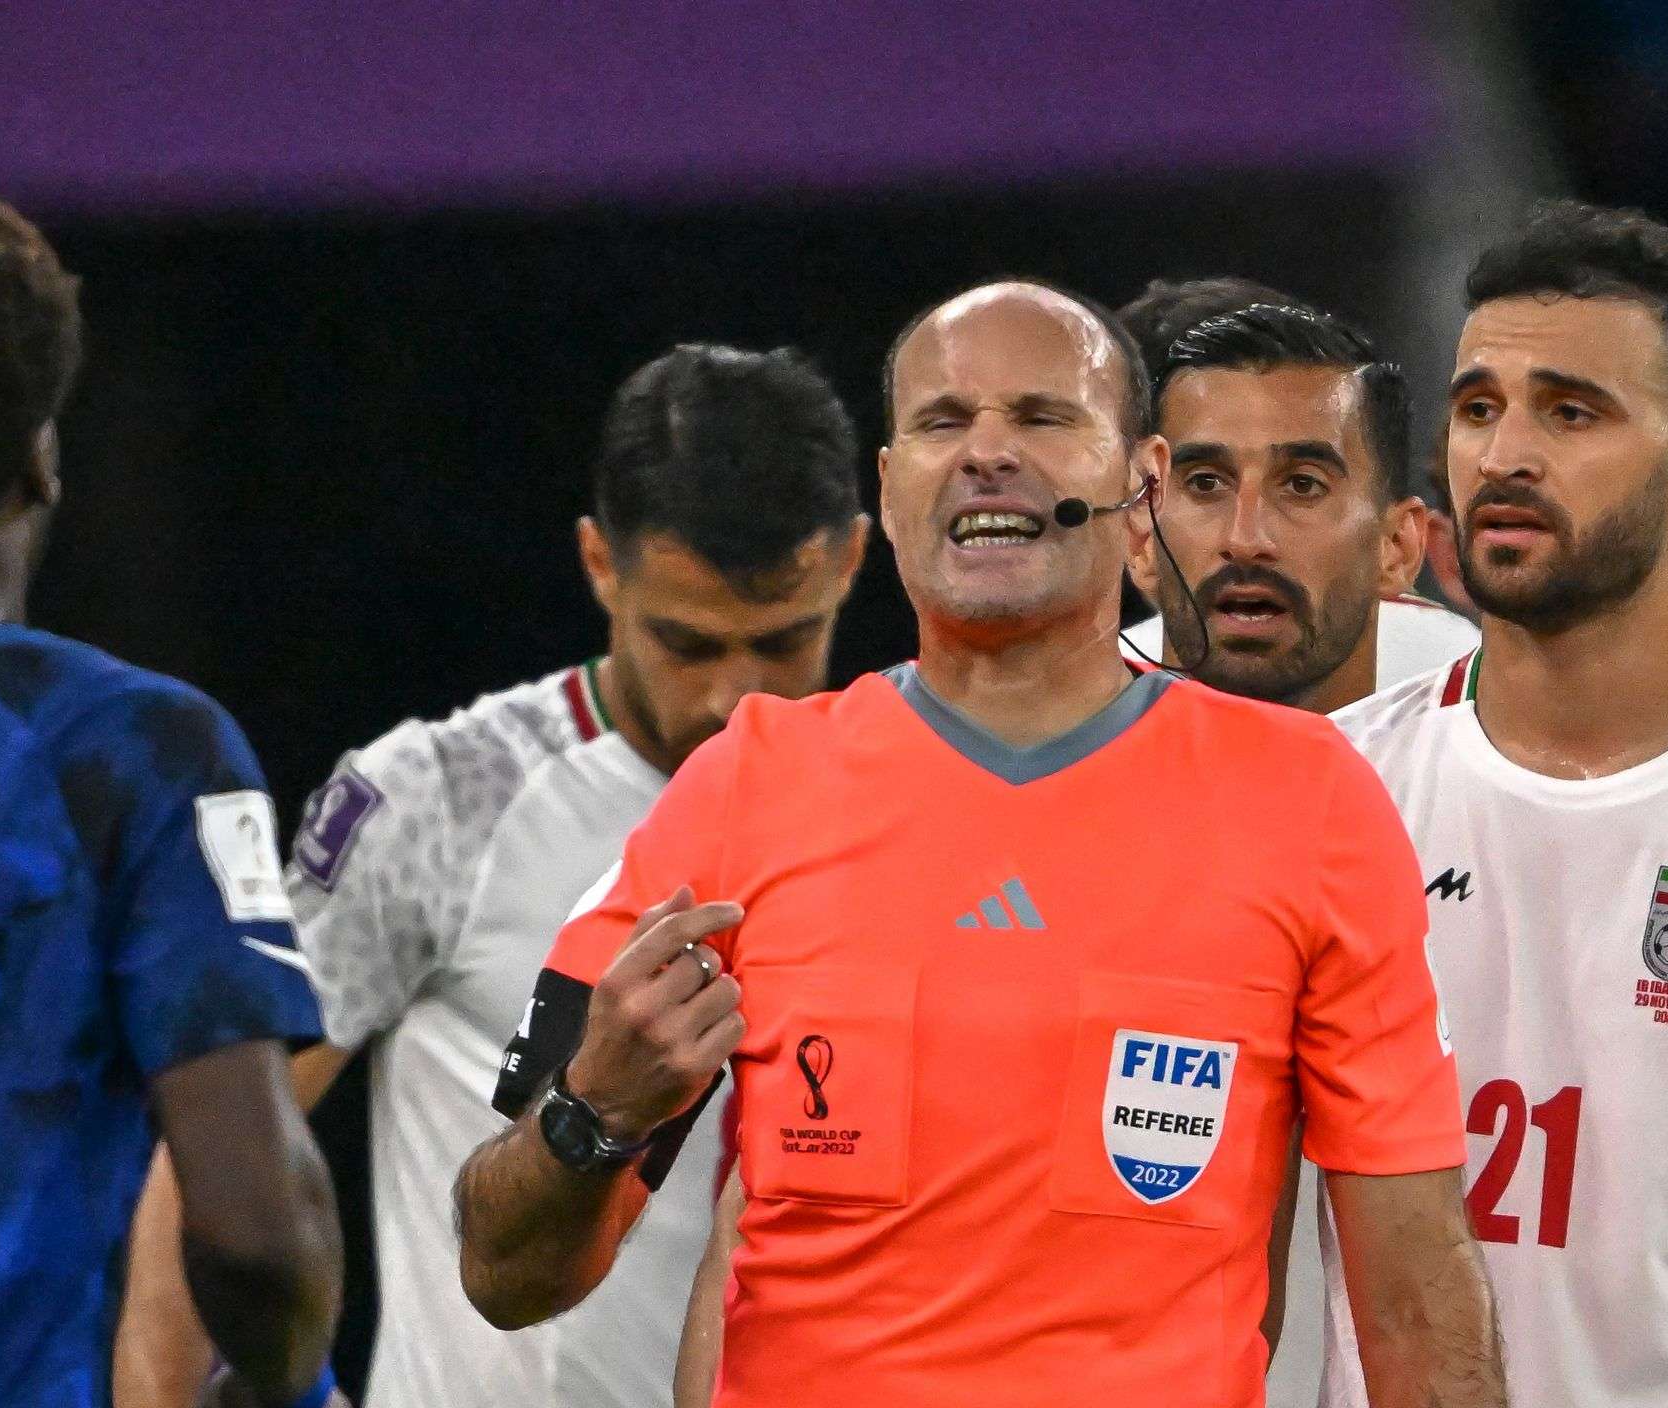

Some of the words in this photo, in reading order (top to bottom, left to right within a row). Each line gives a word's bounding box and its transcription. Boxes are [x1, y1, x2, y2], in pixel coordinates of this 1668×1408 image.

[1635, 993, 1649, 1006] 29
[1122, 1039, 1221, 1090] FIFA
[796, 1129, 837, 1140] WORLD
[839, 1130, 861, 1141] CUP
[1113, 1105, 1215, 1138] REFEREE
[1132, 1164, 1181, 1188] 2022
[1465, 1078, 1583, 1249] 21
